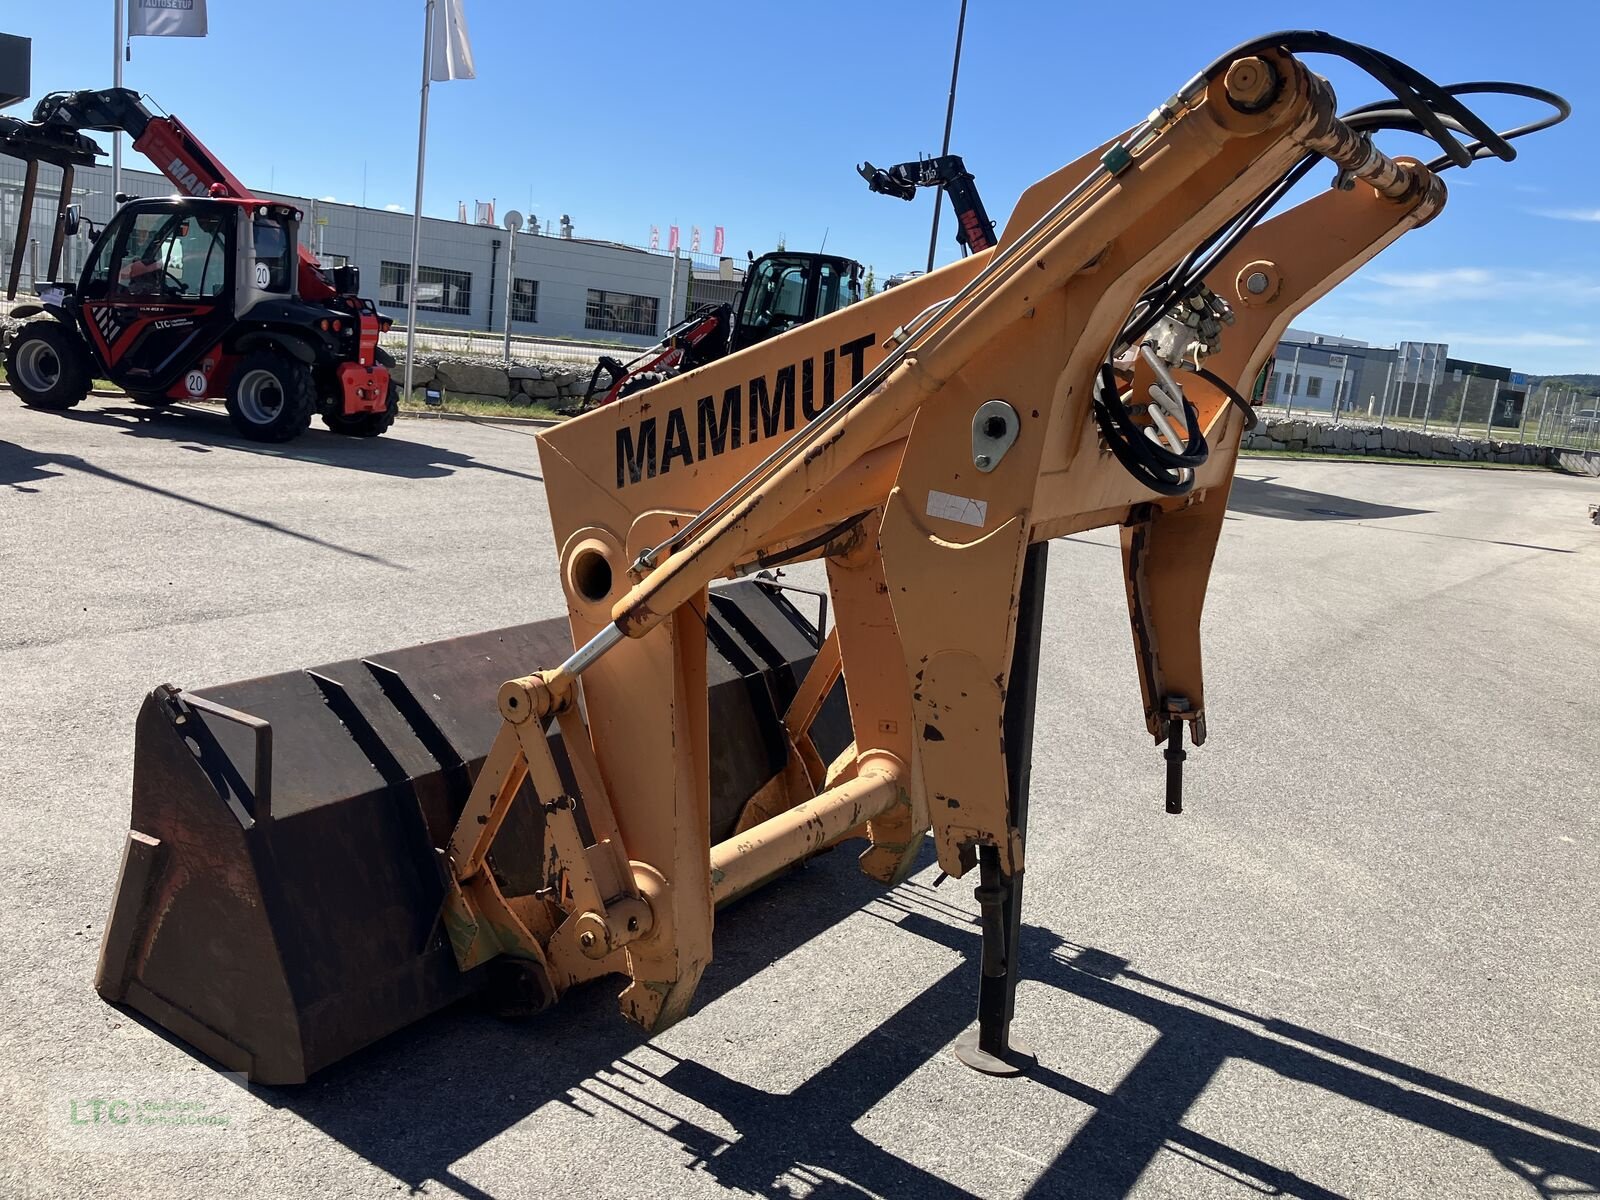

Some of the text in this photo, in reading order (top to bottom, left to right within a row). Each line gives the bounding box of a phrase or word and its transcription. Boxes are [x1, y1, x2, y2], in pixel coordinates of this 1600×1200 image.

[256, 267, 268, 285] 20
[154, 320, 171, 330] LTC
[189, 374, 203, 392] 20
[616, 333, 876, 489] MAMMUT
